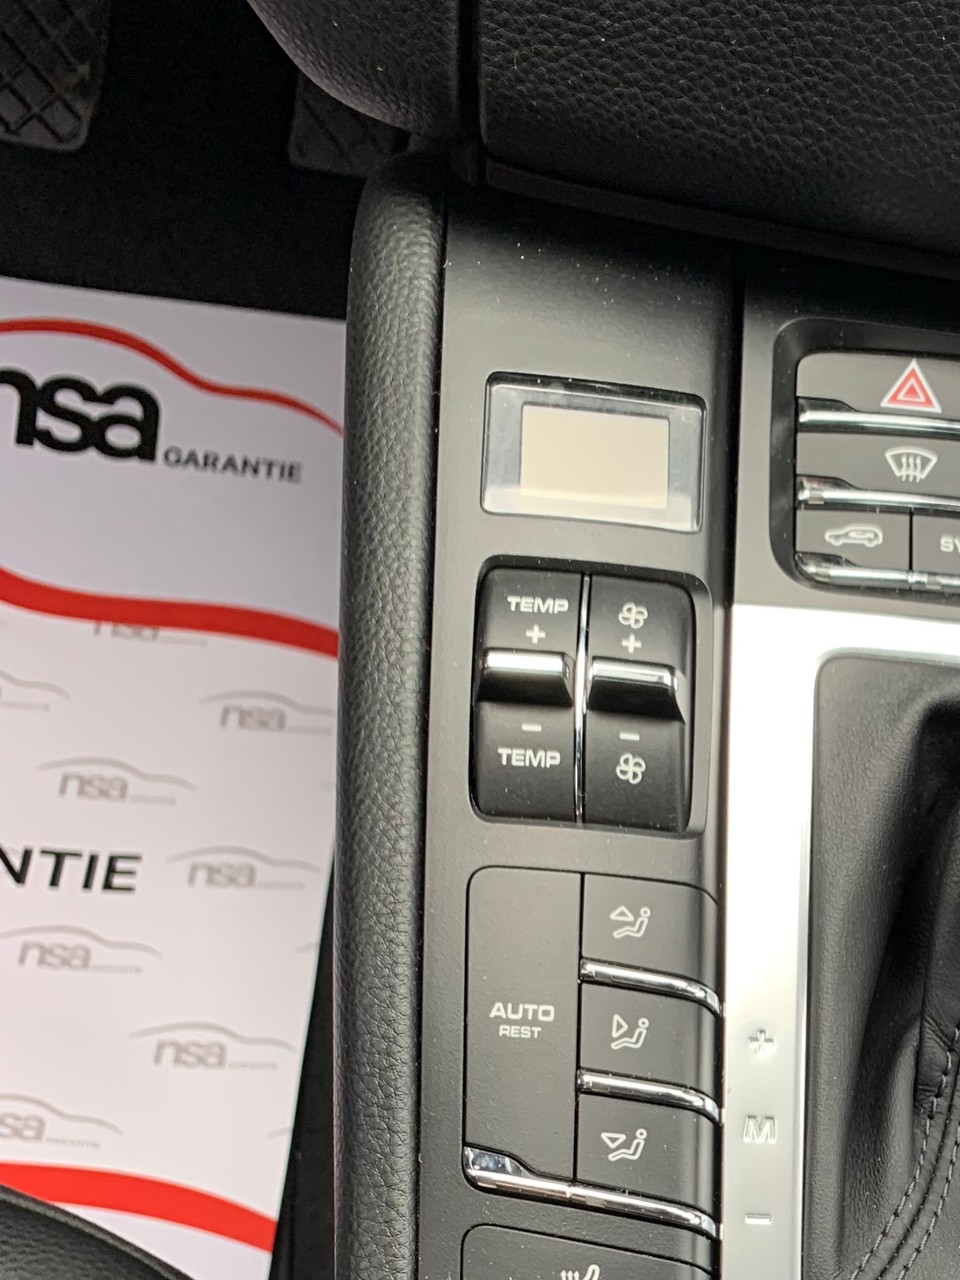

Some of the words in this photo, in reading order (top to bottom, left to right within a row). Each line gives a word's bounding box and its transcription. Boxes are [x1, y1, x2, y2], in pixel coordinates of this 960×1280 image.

[163, 446, 303, 484] GARANTIE
[507, 596, 569, 614] TEMP
[497, 747, 561, 769] TEMP
[489, 1002, 555, 1022] AUTO
[498, 1024, 542, 1039] REST
[743, 1114, 777, 1145] M
